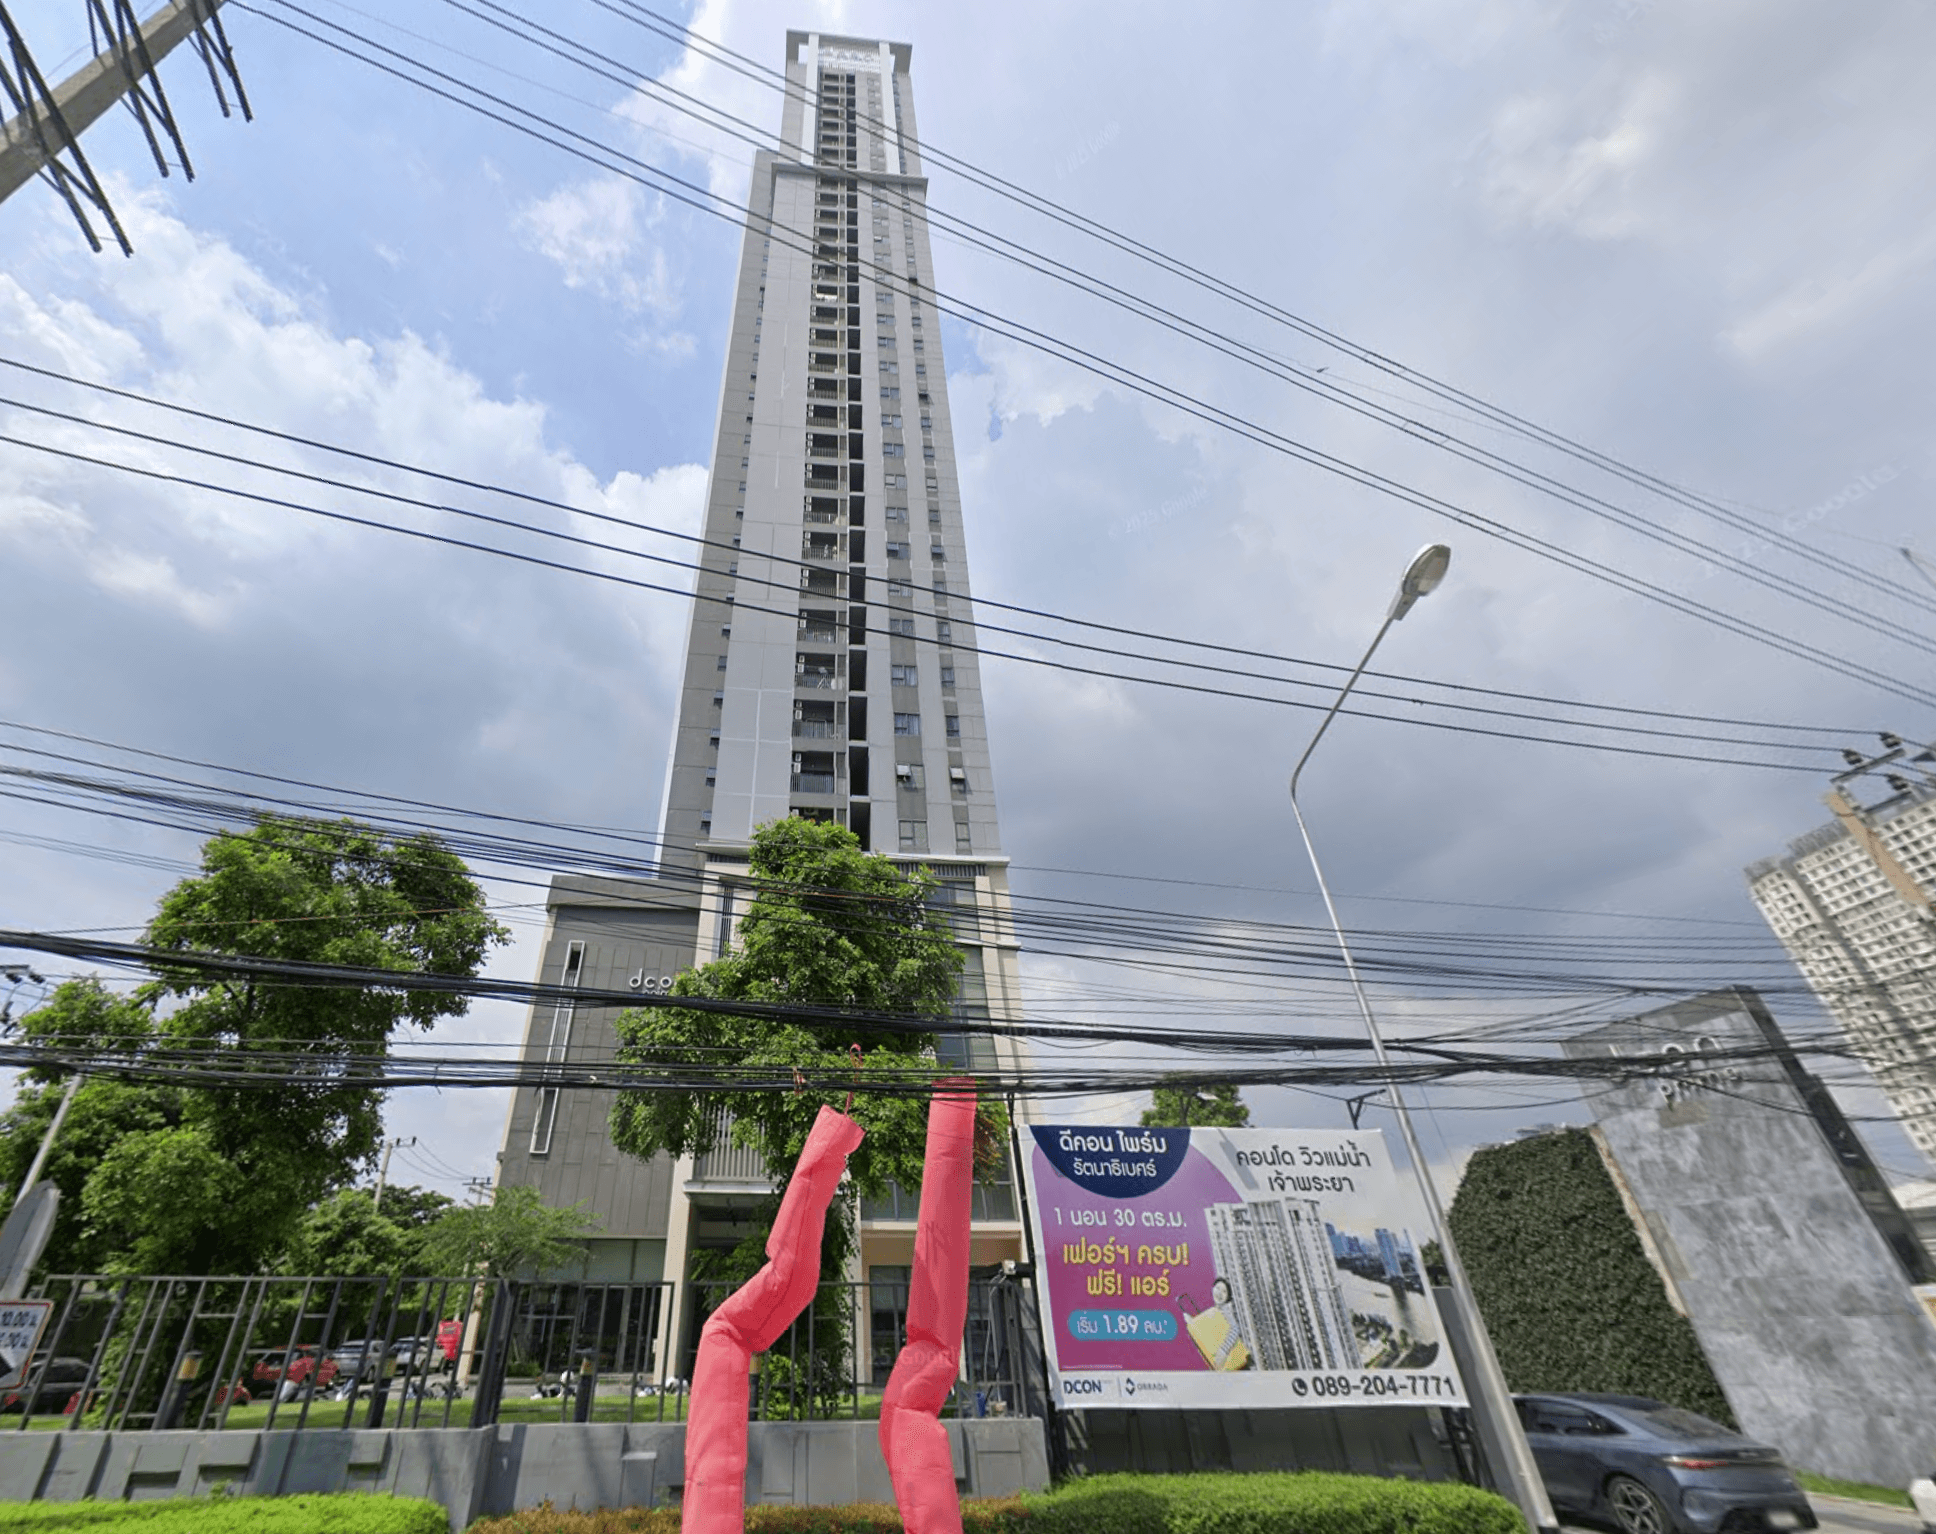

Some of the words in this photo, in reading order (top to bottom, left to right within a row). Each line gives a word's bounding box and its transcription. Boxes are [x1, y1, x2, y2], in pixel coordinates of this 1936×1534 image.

[1059, 1129, 1114, 1152] ดีคอน
[1116, 1130, 1167, 1153] ไพร์ม
[1236, 1145, 1296, 1166] คอนโด
[1298, 1139, 1371, 1167] วิวแม่น้ำ
[1073, 1157, 1157, 1177] รัตนาธิเบศร์
[1267, 1169, 1354, 1192] เจ้าพระยา
[1054, 1207, 1062, 1225] 1
[1070, 1210, 1107, 1226] นอน
[1113, 1208, 1135, 1227] 30
[1141, 1211, 1187, 1227] ตร.ม.
[1063, 1236, 1130, 1265] เฟอร์ฯ
[1137, 1242, 1189, 1267] ครบ!
[1087, 1268, 1122, 1296] ฟรี!
[1130, 1268, 1170, 1296] แอร์
[1102, 1314, 1139, 1334] 1.89
[1063, 1379, 1102, 1395] DCON
[1311, 1375, 1456, 1397] 089-204-7771
